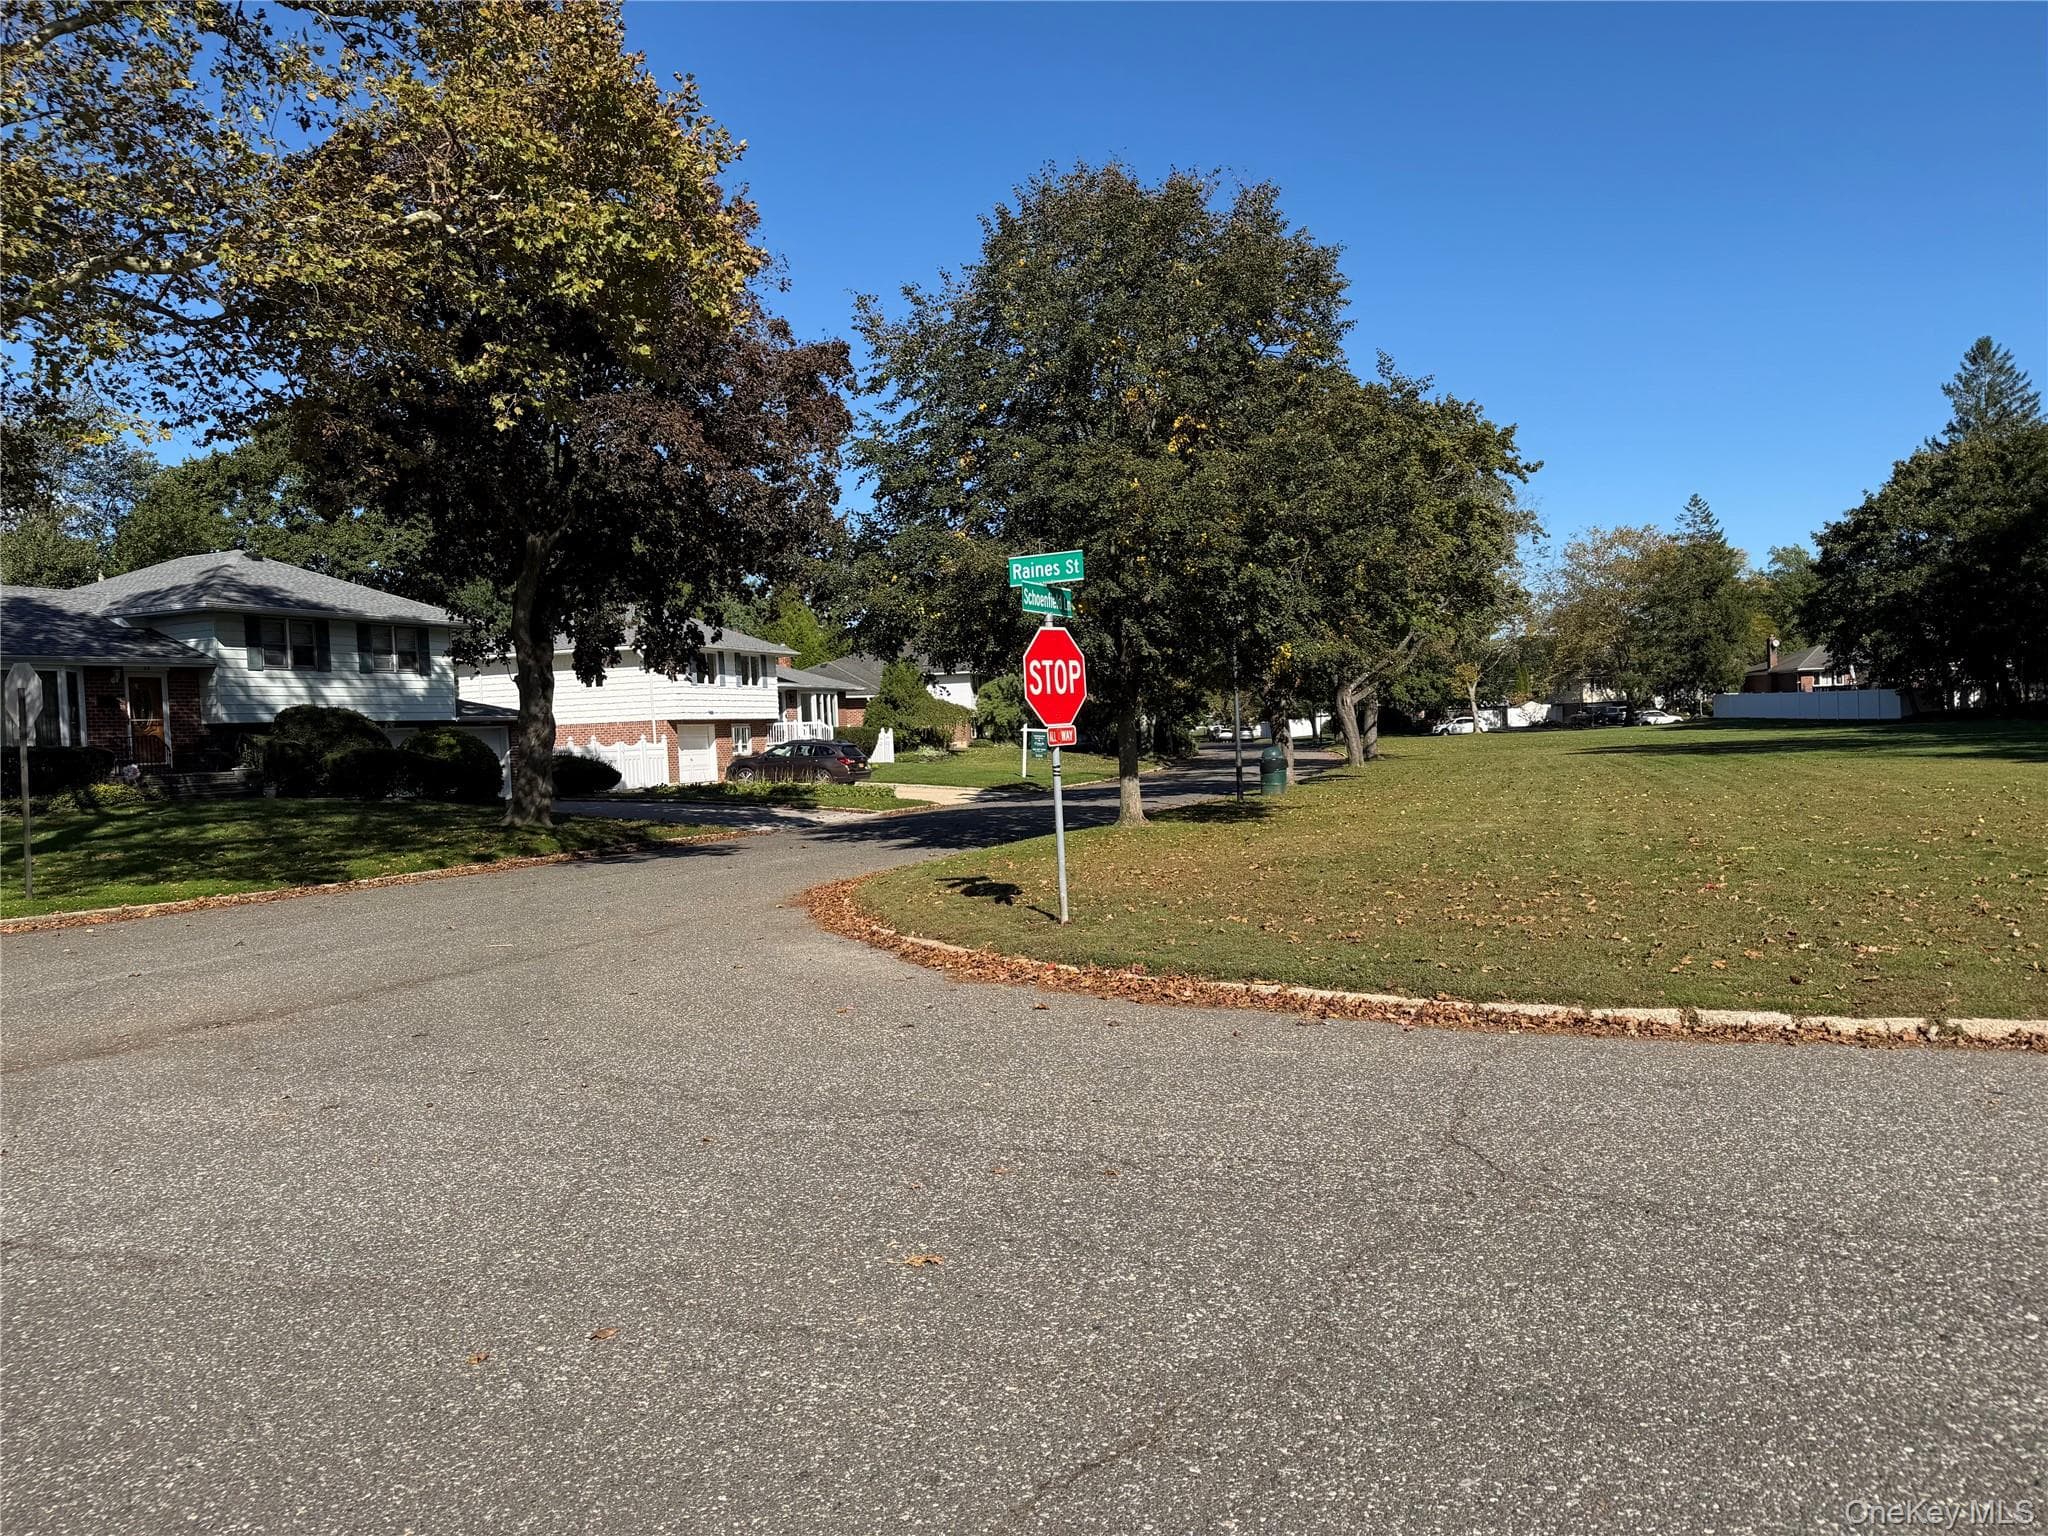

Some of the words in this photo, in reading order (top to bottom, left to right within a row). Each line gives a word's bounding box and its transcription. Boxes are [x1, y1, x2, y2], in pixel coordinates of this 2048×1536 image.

[1012, 562, 1060, 579] Raines
[1065, 559, 1080, 574] St
[1029, 659, 1081, 695] STOP
[1060, 730, 1074, 741] WAY
